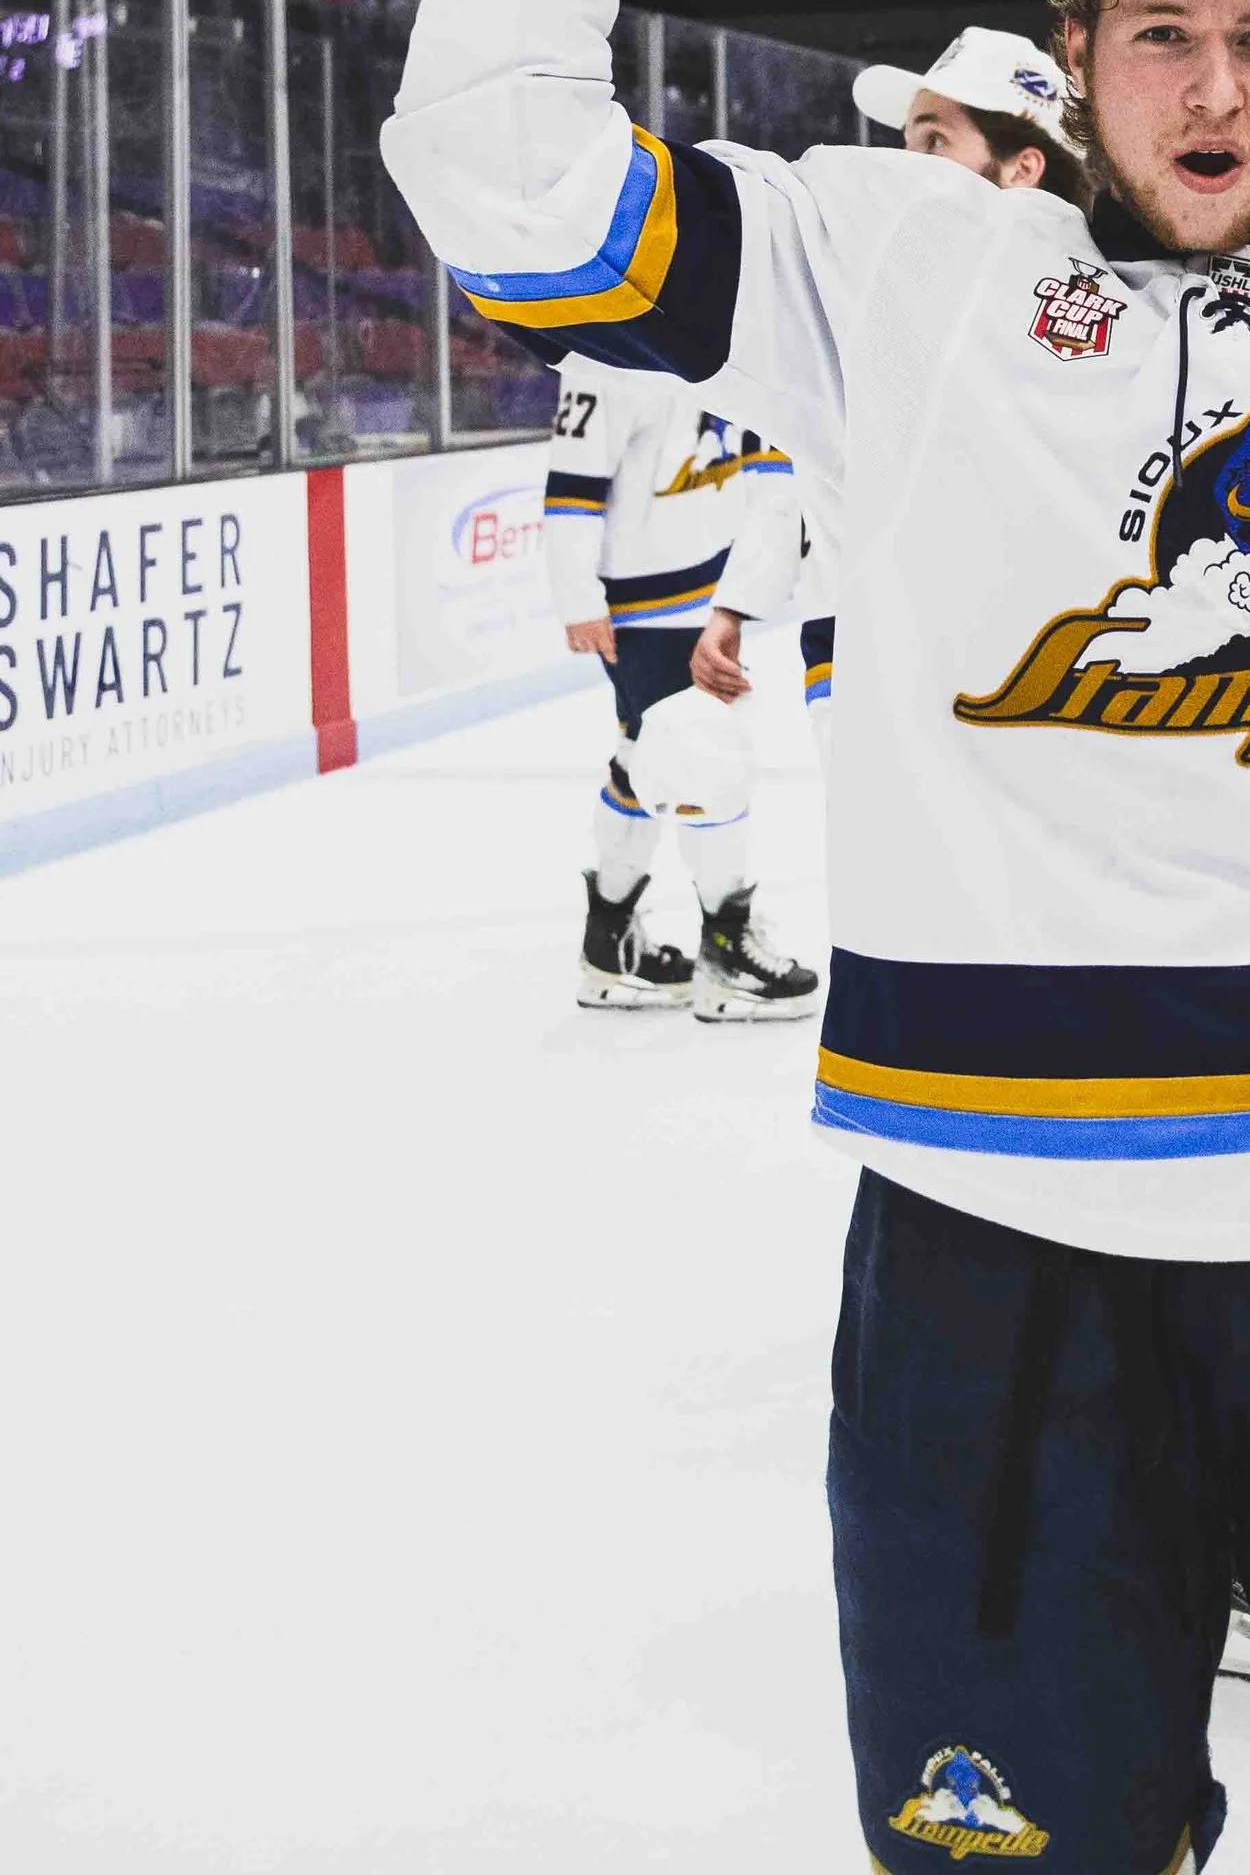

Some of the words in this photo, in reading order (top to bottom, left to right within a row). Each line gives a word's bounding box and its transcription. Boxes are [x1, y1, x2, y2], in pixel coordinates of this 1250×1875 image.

[1036, 279, 1126, 318] CLARK
[1212, 272, 1250, 292] USHL
[1045, 298, 1104, 324] CUP
[1052, 319, 1091, 342] FINAL
[1119, 398, 1243, 544] SIOUX
[0, 512, 242, 629] SHAFER
[0, 602, 244, 733] SWARTZ
[888, 1798, 1051, 1862] Stampede
